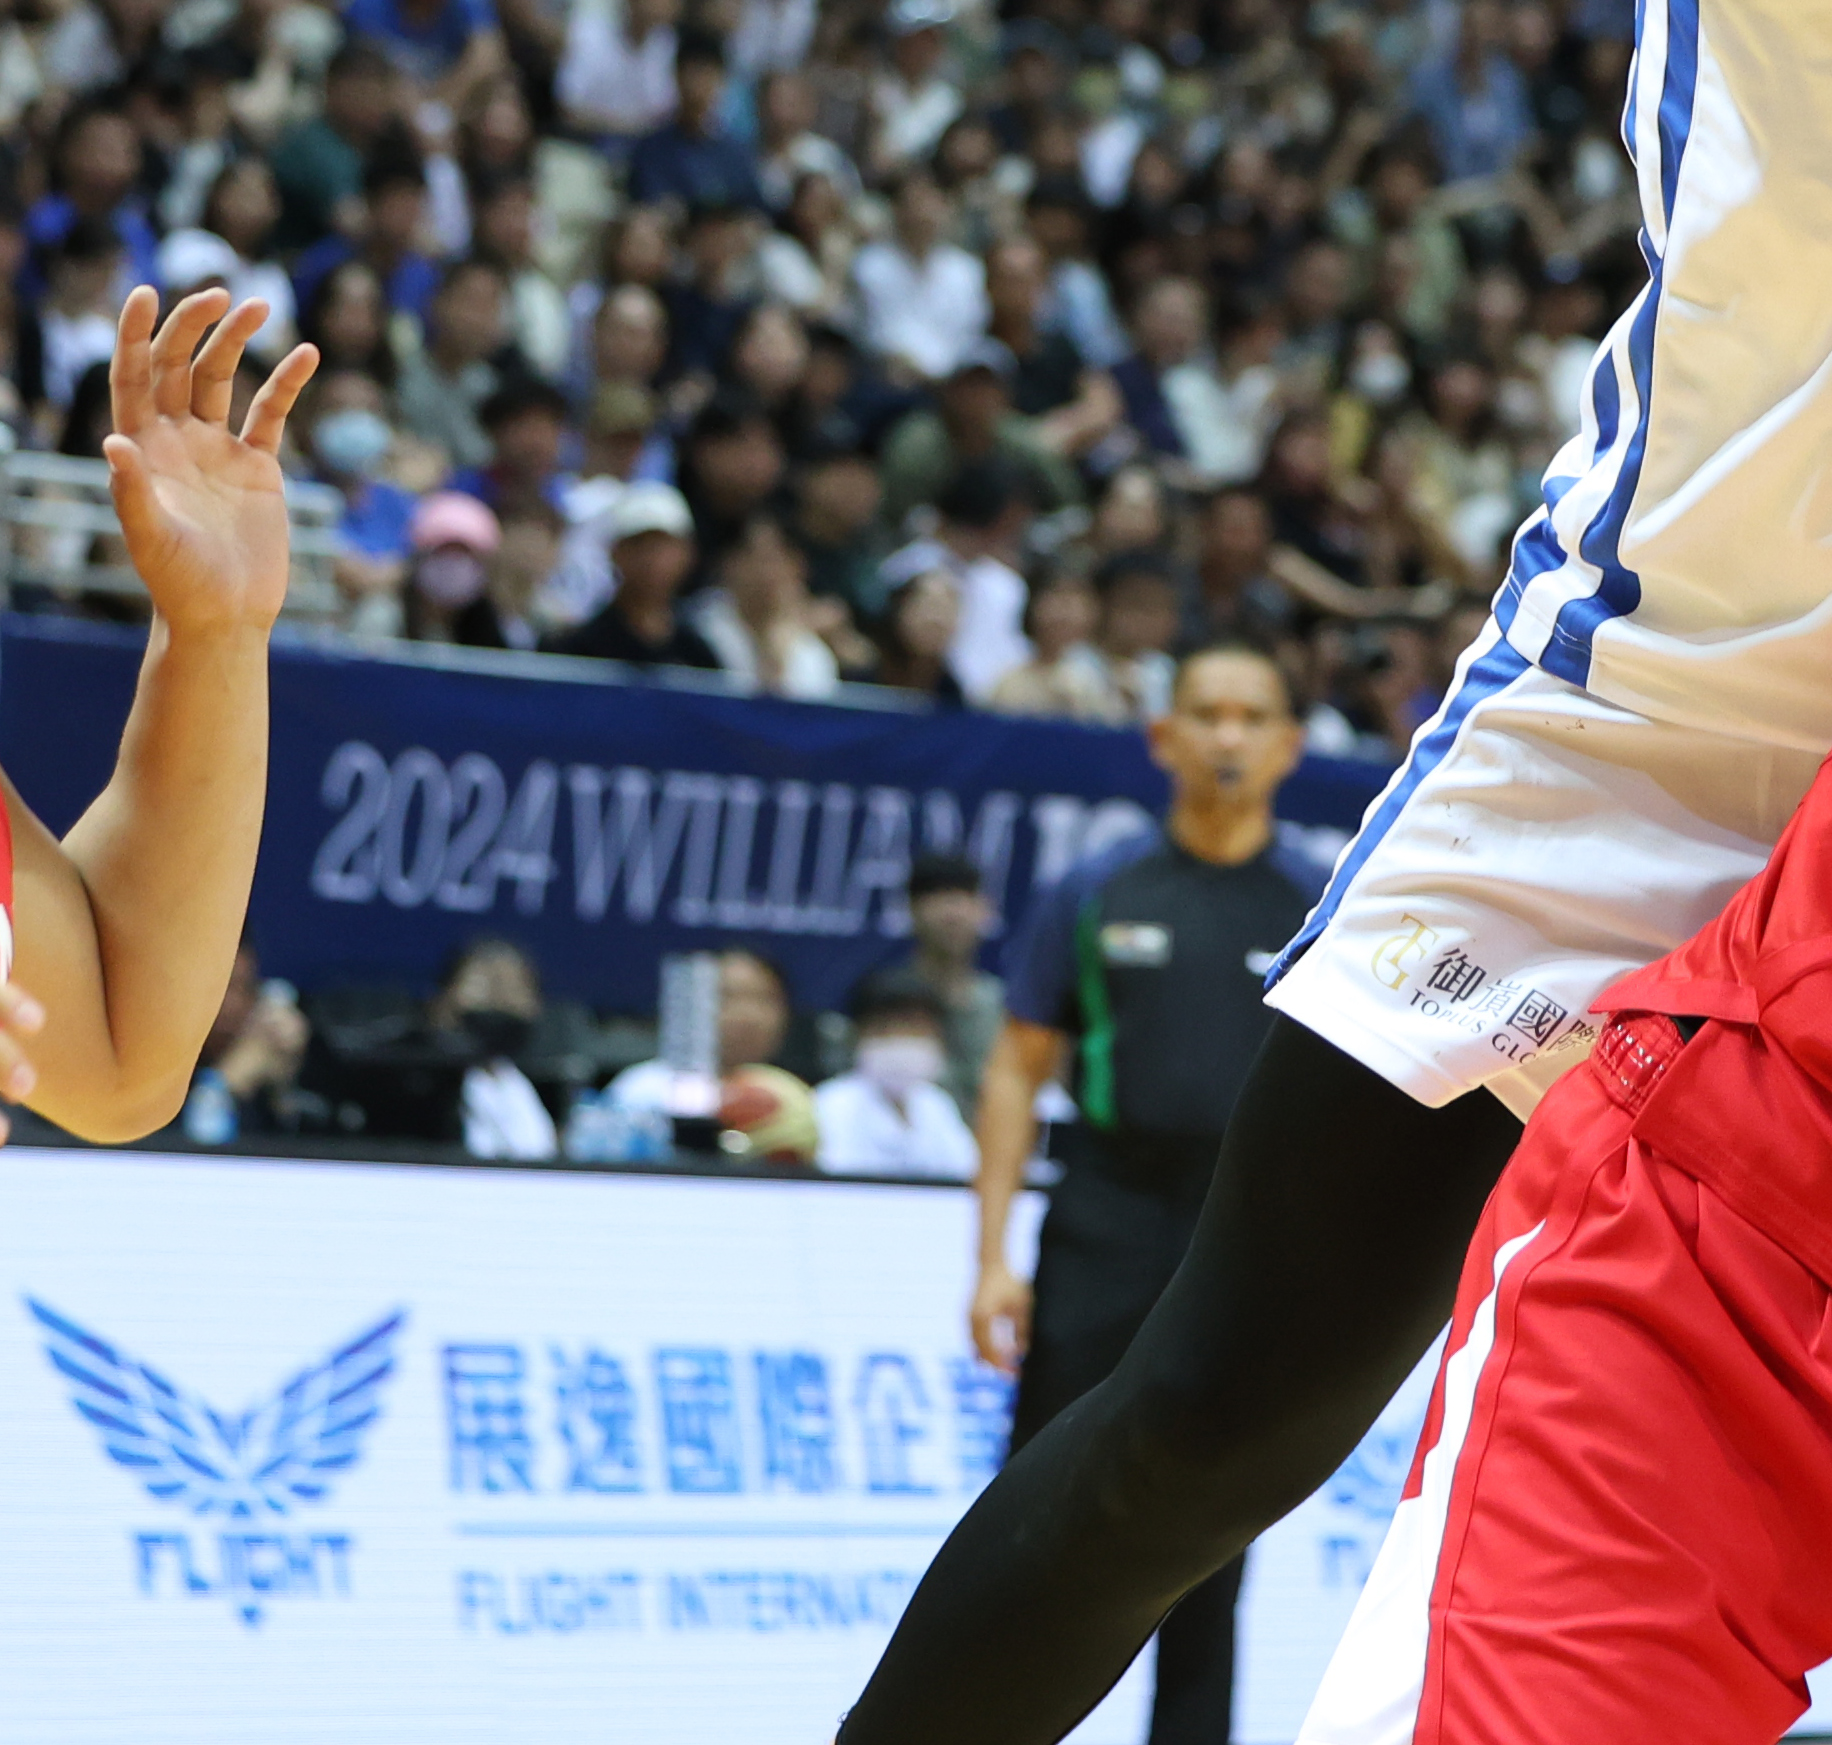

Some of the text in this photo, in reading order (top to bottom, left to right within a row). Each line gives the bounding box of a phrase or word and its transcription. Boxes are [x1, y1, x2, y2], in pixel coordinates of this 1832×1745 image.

[310, 740, 557, 916] 2024
[1409, 988, 1487, 1034] TOPLUS
[456, 1568, 637, 1634] FLIGHT
